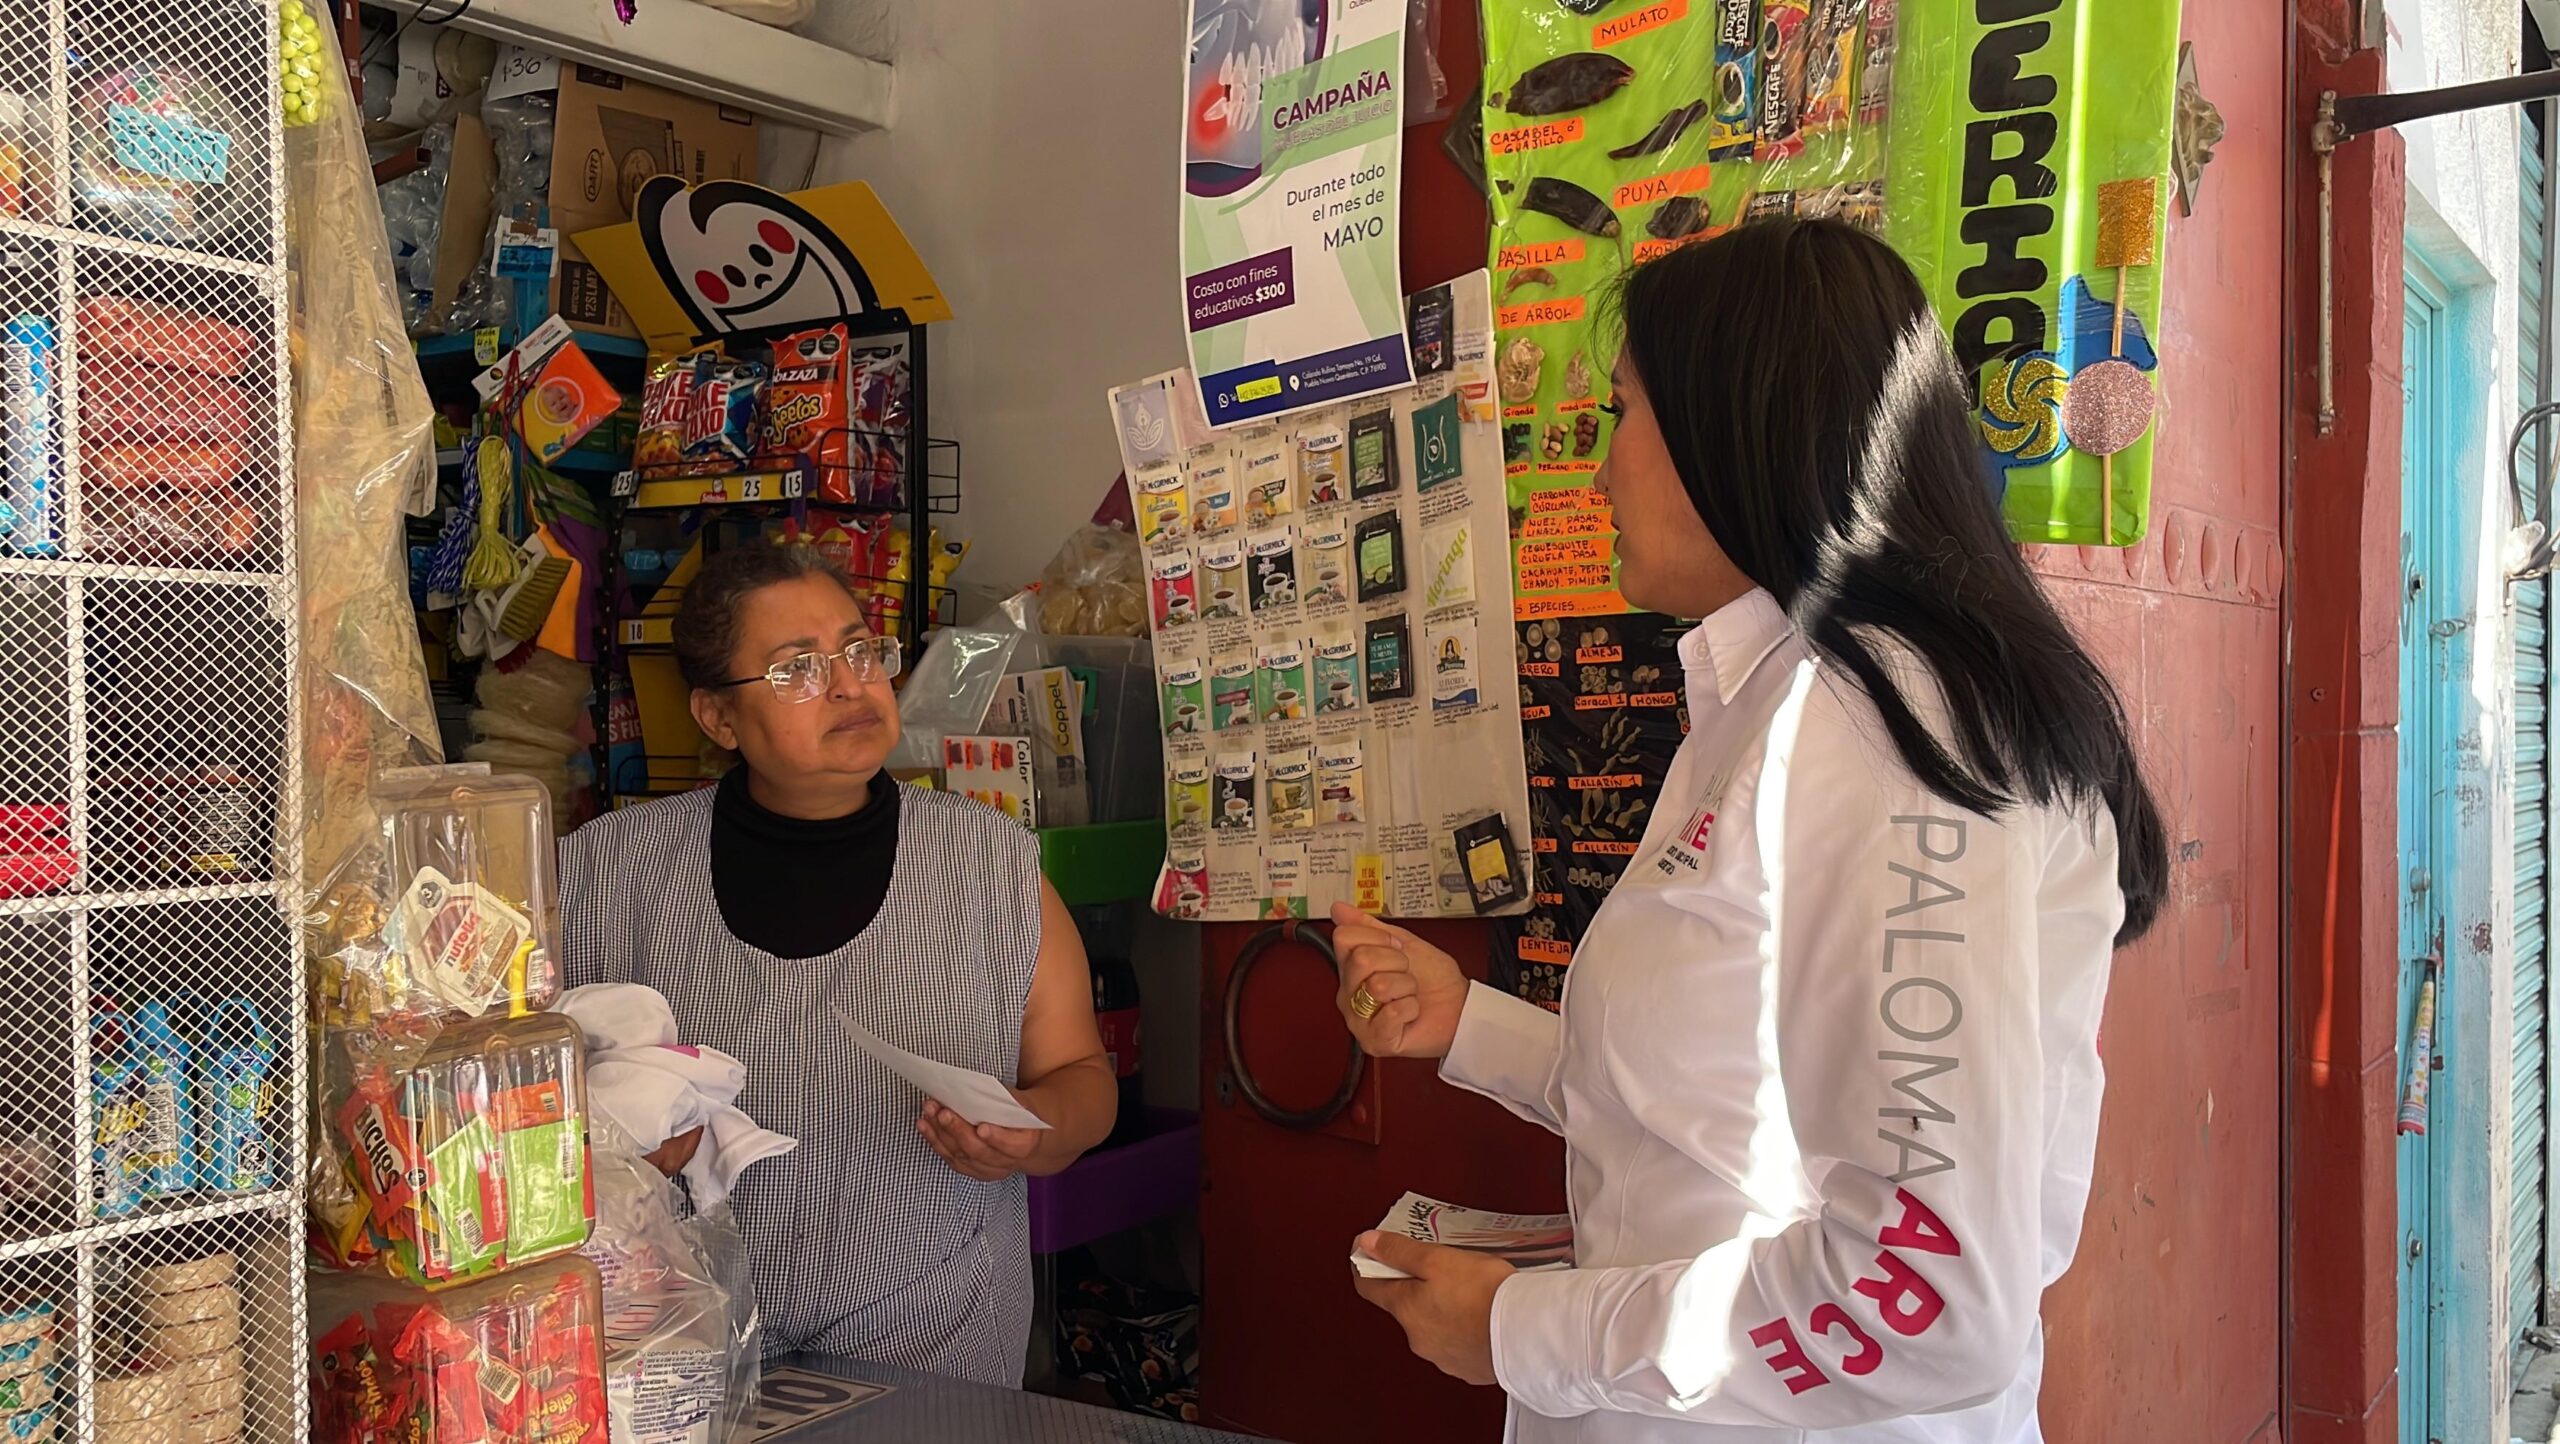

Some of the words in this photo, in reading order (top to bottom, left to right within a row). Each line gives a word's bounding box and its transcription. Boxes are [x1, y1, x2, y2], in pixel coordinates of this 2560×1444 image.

[1601, 7, 1669, 40] MULATO
[1273, 70, 1392, 129] CAMPAÑA
[1504, 135, 1565, 154] GUAJILLO
[1287, 175, 1346, 206] Durante
[1351, 164, 1385, 187] todo
[1617, 179, 1668, 205] PUYA
[1312, 202, 1325, 221] el
[1330, 194, 1362, 217] mes
[1366, 188, 1385, 206] de
[1952, 0, 2062, 410] ERIA
[1323, 216, 1383, 251] MAYO
[1497, 245, 1566, 268] PASILLA
[1193, 281, 1223, 299] Costo
[1226, 275, 1247, 291] con
[1249, 264, 1278, 285] fines
[1194, 294, 1254, 319] educativos
[1256, 282, 1286, 303] $300
[1501, 312, 1518, 325] DE
[617, 474, 632, 492] 25
[744, 479, 761, 497] 25
[787, 475, 801, 496] 15
[631, 621, 643, 640] 18
[1580, 647, 1620, 658] ALMEJA
[1519, 664, 1554, 675] BRERO
[1049, 680, 1070, 747] Coppel
[1575, 695, 1613, 707] Caracol
[1635, 695, 1674, 706] HONGO
[1016, 739, 1031, 785] Color
[1573, 775, 1623, 787] TALLARÍN
[1574, 842, 1629, 853] TALLARÍN
[445, 912, 483, 968] nutella
[1520, 939, 1570, 954] LENTEJA
[1877, 815, 1968, 1183] PALOMA
[1748, 1186, 1962, 1396] ARCE
